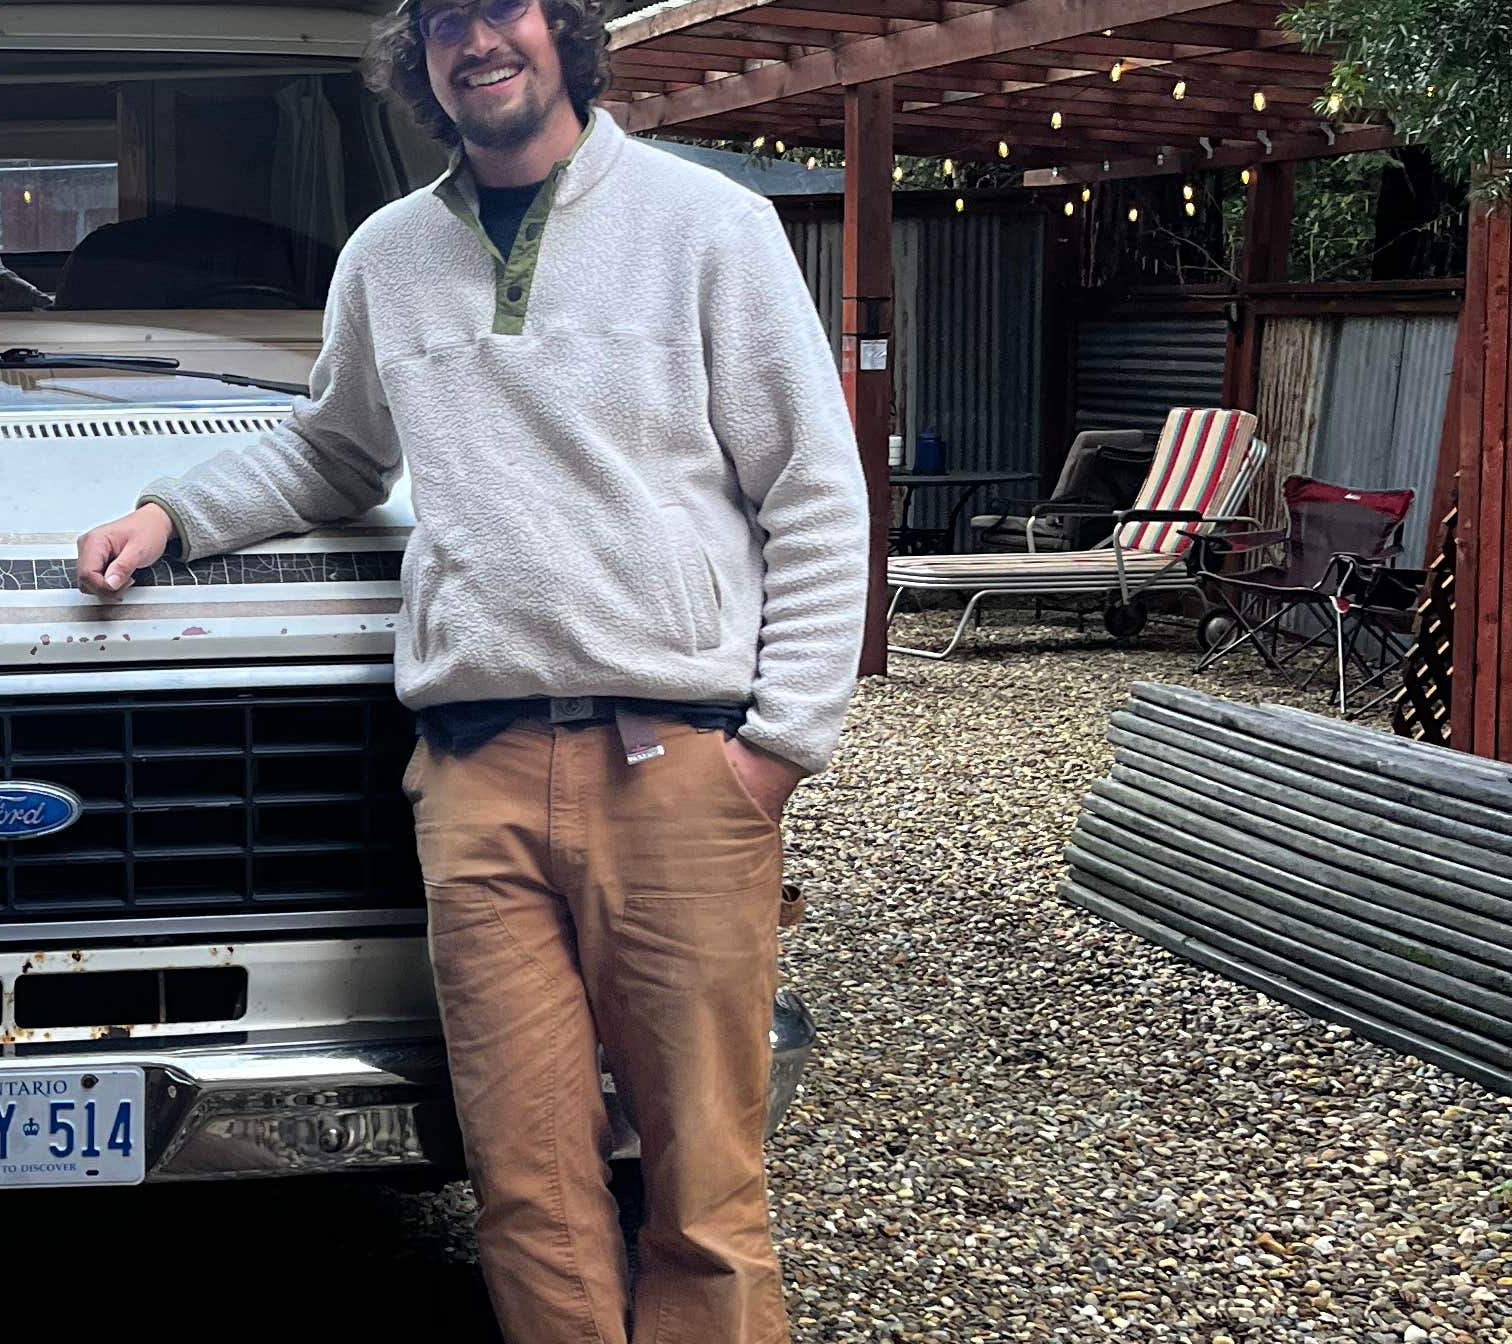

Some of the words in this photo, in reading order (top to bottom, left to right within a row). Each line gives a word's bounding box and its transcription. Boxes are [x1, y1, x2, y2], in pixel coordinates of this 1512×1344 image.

[49, 1099, 133, 1159] 514
[2, 1164, 17, 1174] TO
[20, 1162, 77, 1173] DISCOVER
